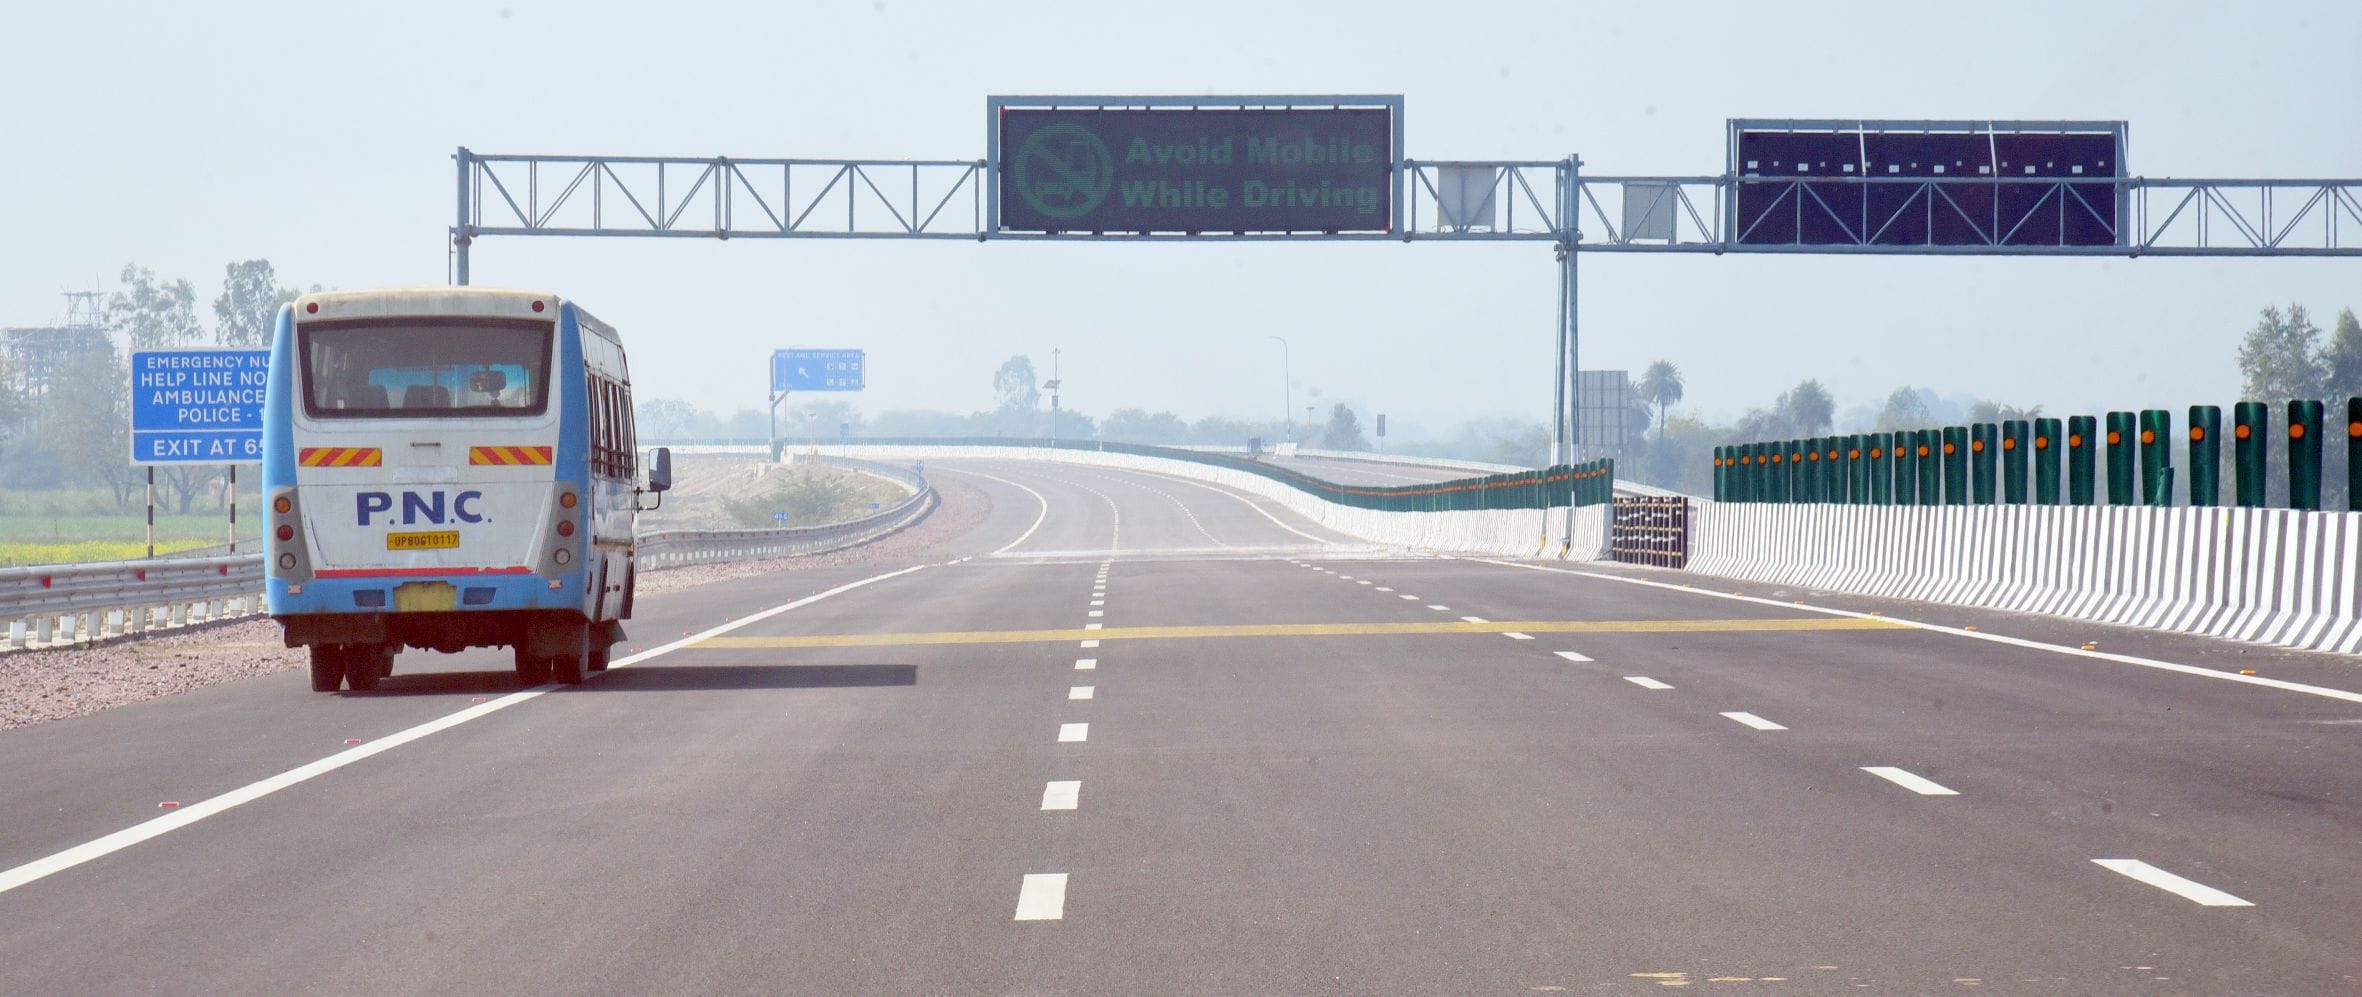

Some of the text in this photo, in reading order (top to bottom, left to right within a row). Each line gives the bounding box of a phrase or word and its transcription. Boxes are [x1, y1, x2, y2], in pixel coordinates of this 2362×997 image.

[1125, 137, 1375, 165] Avoid Mobile
[1120, 180, 1378, 214] While Driving
[147, 356, 244, 369] EMERGENCY
[141, 371, 266, 387] HELP LINE NO
[152, 389, 265, 405] AMBULANCE
[178, 408, 241, 423] POLICE
[153, 439, 202, 456] EXIT
[210, 439, 237, 456] AT
[356, 490, 492, 526] P.N.C.
